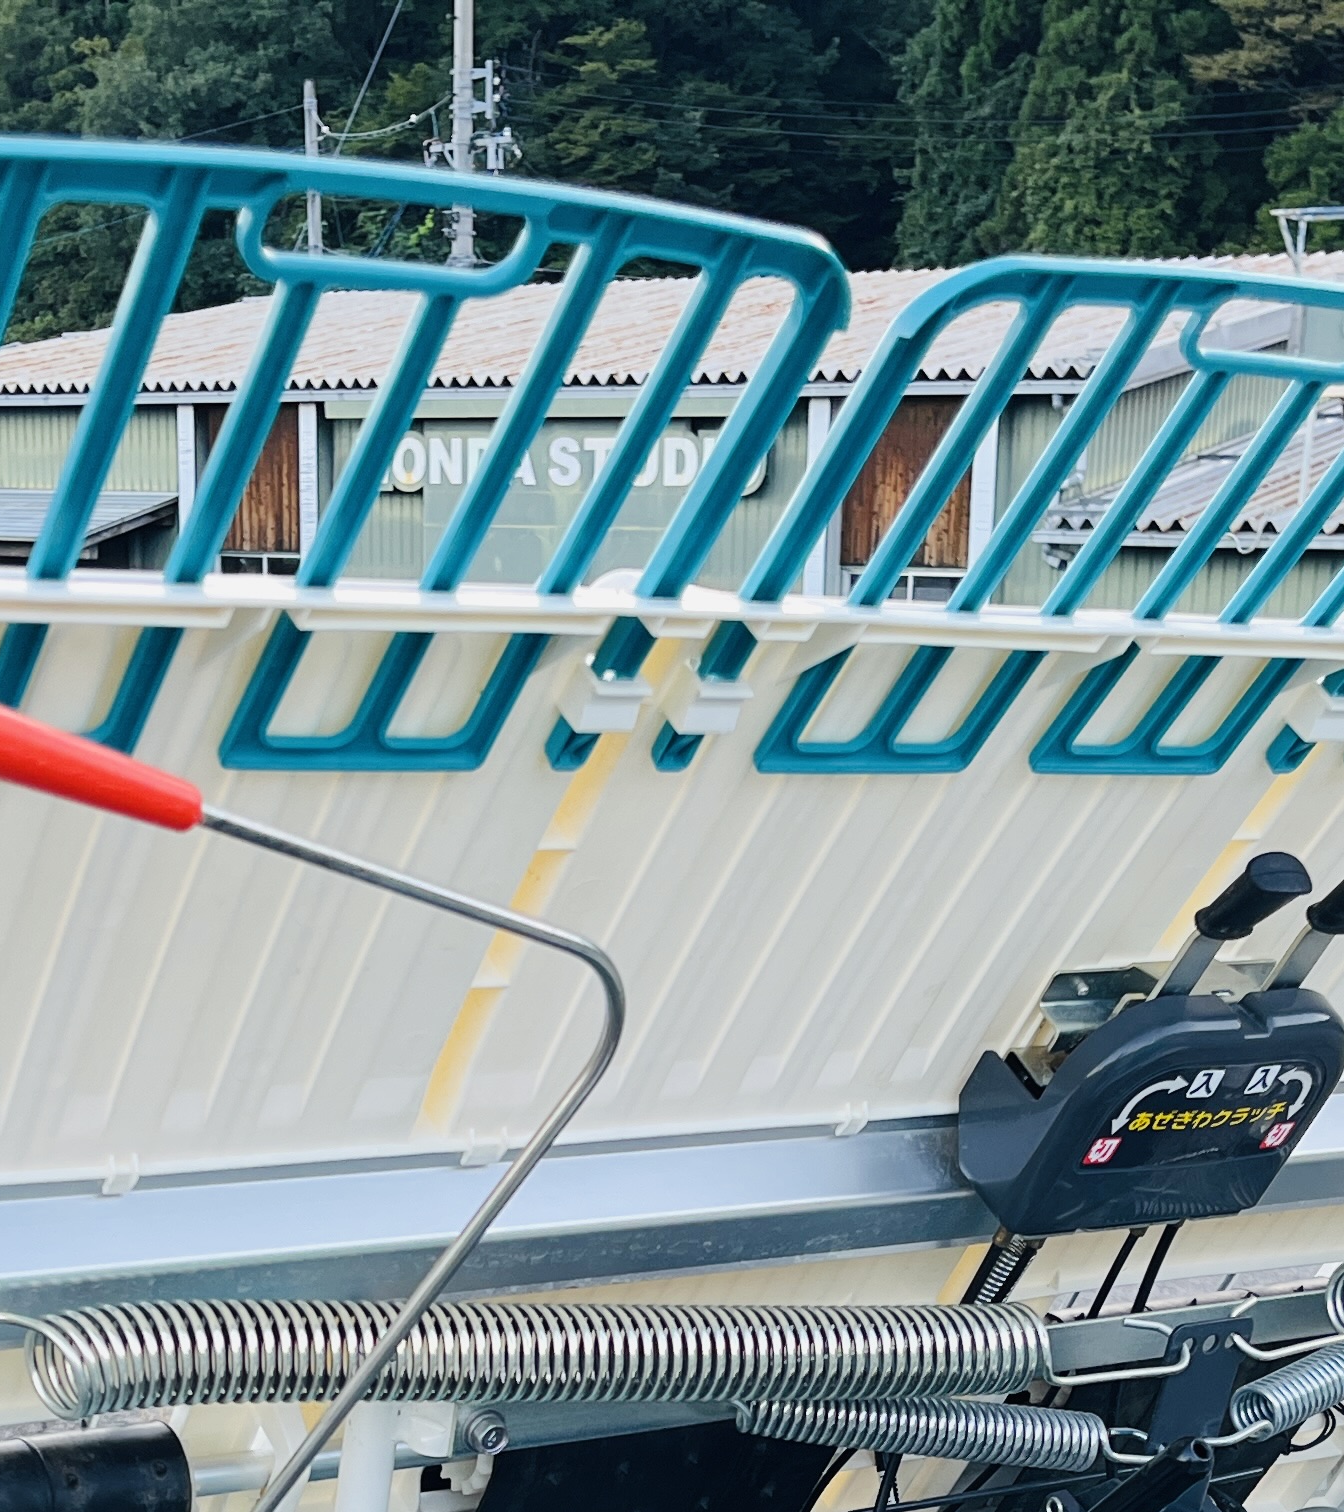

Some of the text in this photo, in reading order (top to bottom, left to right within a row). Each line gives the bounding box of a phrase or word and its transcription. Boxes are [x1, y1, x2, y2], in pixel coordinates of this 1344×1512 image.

[1128, 1101, 1287, 1132] あぜぎわクラッチ
[1264, 1122, 1294, 1148] 切
[1087, 1137, 1117, 1163] 切
